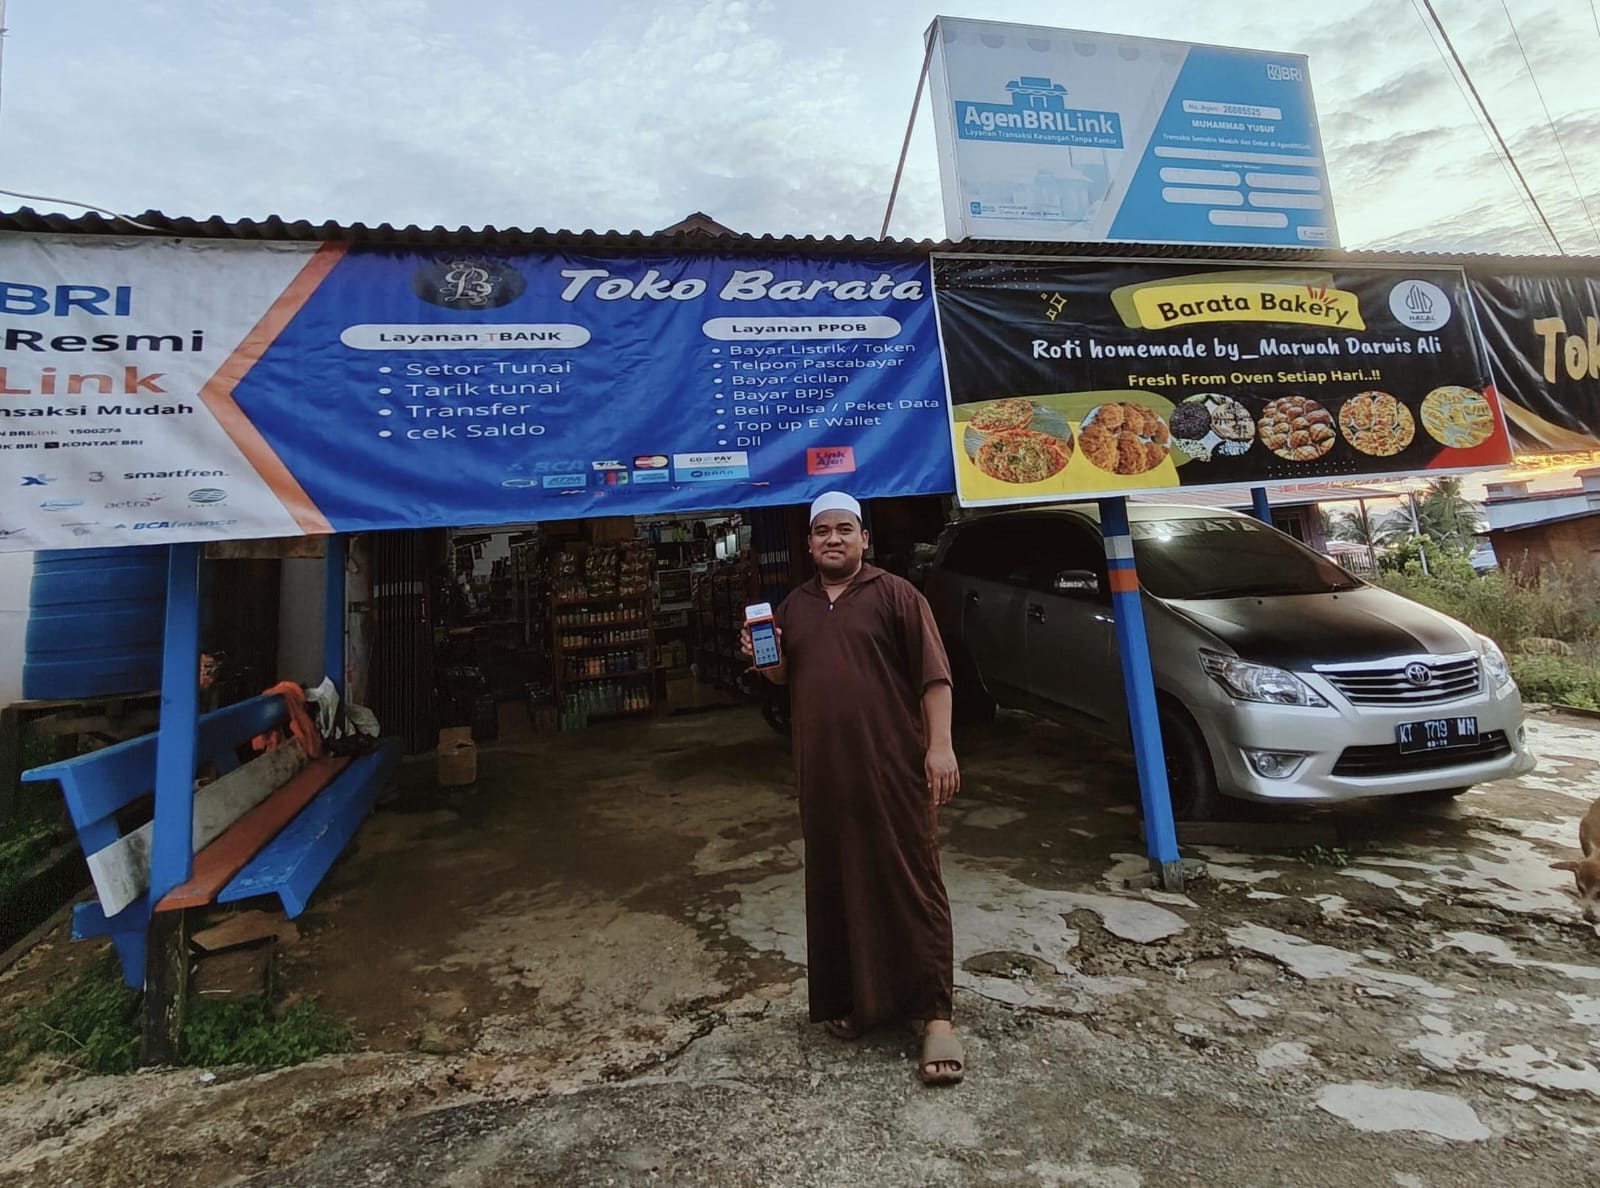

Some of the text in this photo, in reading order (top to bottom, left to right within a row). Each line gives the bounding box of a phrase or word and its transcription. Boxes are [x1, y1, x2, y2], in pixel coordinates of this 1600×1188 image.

[965, 106, 1115, 134] AgenBRILink
[1192, 120, 1276, 133] MUHAMMAD YUSUF
[559, 269, 925, 301] Toko Barata
[0, 281, 131, 317] BRI
[1158, 292, 1350, 325] Barata Bakery
[732, 323, 867, 336] Layanan PPOB
[5, 328, 203, 351] Resmi
[379, 332, 479, 345] Layanan
[1032, 339, 1081, 359] Roti
[1089, 337, 1207, 359] homemade
[1346, 338, 1412, 356] Darwis
[1417, 335, 1442, 355] Ali
[730, 345, 784, 357] Bayar
[791, 343, 847, 355] Listrik
[863, 342, 916, 353] Token
[406, 360, 572, 377] Setor Tunai
[730, 357, 905, 372] Telpon Pascabayar
[0, 365, 168, 395] Link
[732, 373, 849, 387] Bayar cicilan
[1128, 374, 1176, 387] Fresh
[1182, 373, 1226, 386] From
[1231, 372, 1274, 385] Oven
[1278, 370, 1327, 386] Setiap
[405, 381, 561, 397] Tarik tunai
[733, 388, 835, 402] Bayar BPJS
[97, 403, 194, 416] Mudah
[405, 402, 532, 418] Transfer
[734, 405, 769, 416] Beli
[777, 404, 826, 415] Pulsa
[845, 401, 894, 412] Peket
[899, 399, 940, 409] Data
[406, 422, 546, 440] cek Saldo
[735, 416, 882, 433] Top up E Wallet
[62, 440, 119, 448] KONTAK
[1399, 723, 1413, 744] KT
[1424, 719, 1449, 741] 1719
